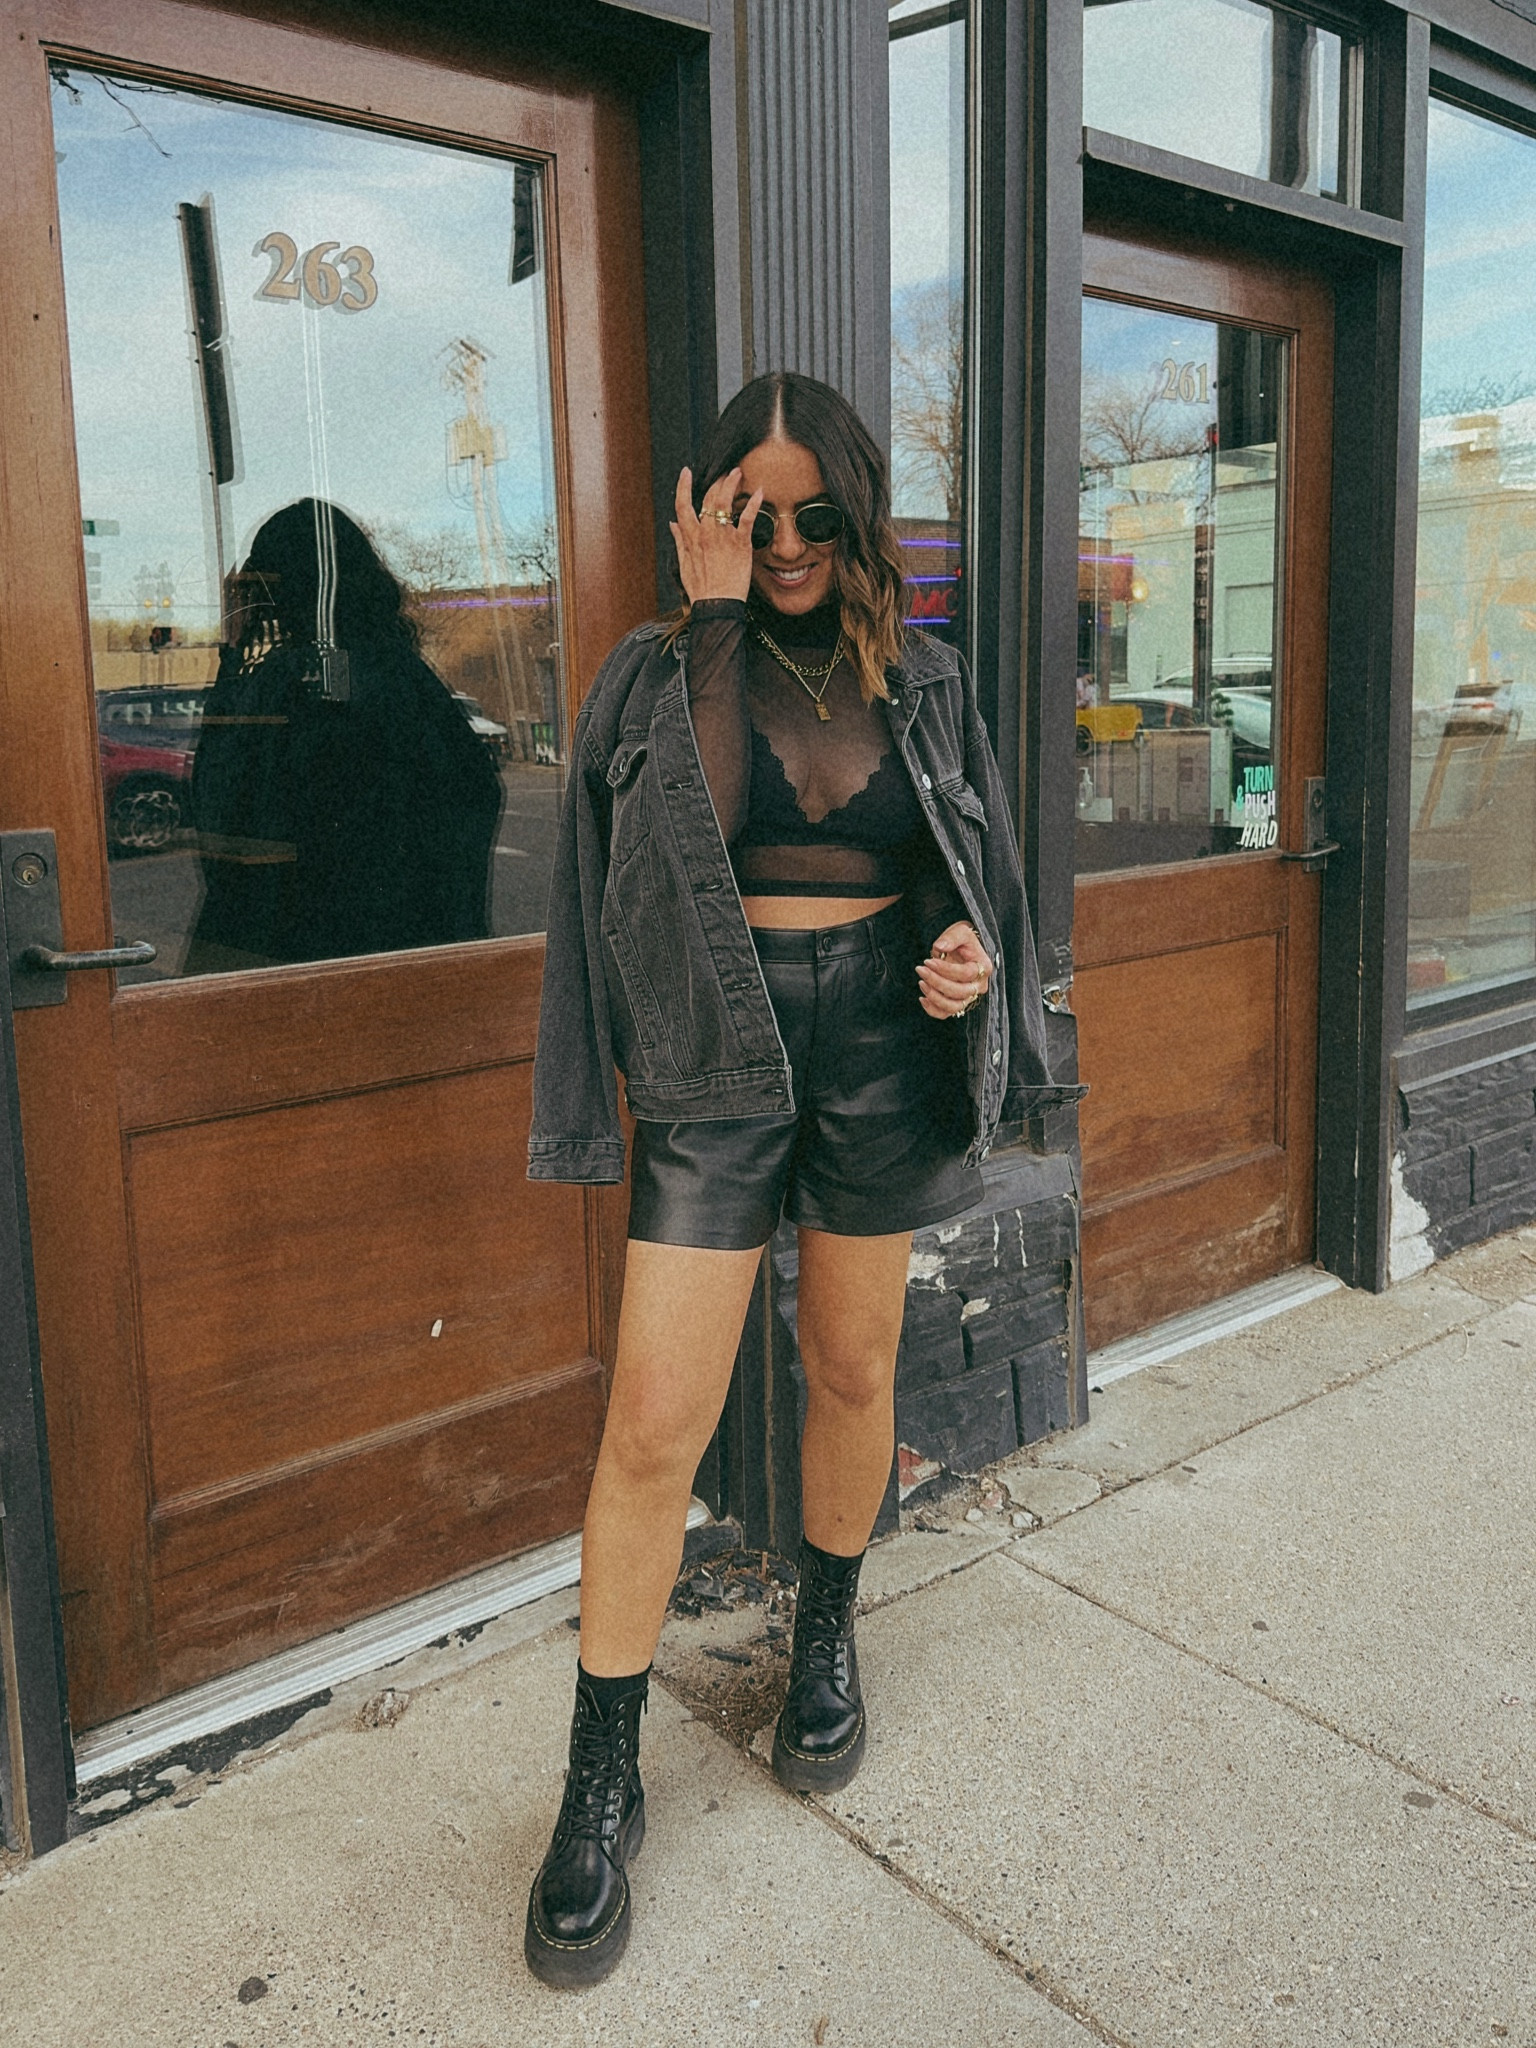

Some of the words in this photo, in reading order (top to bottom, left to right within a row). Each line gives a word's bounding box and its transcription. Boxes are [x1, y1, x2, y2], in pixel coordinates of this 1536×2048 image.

[260, 231, 378, 311] 263
[1161, 358, 1210, 404] 261
[1243, 765, 1273, 793] TURN
[1235, 785, 1244, 811] &
[1244, 790, 1276, 819] PUSH
[1239, 820, 1278, 849] HARD
